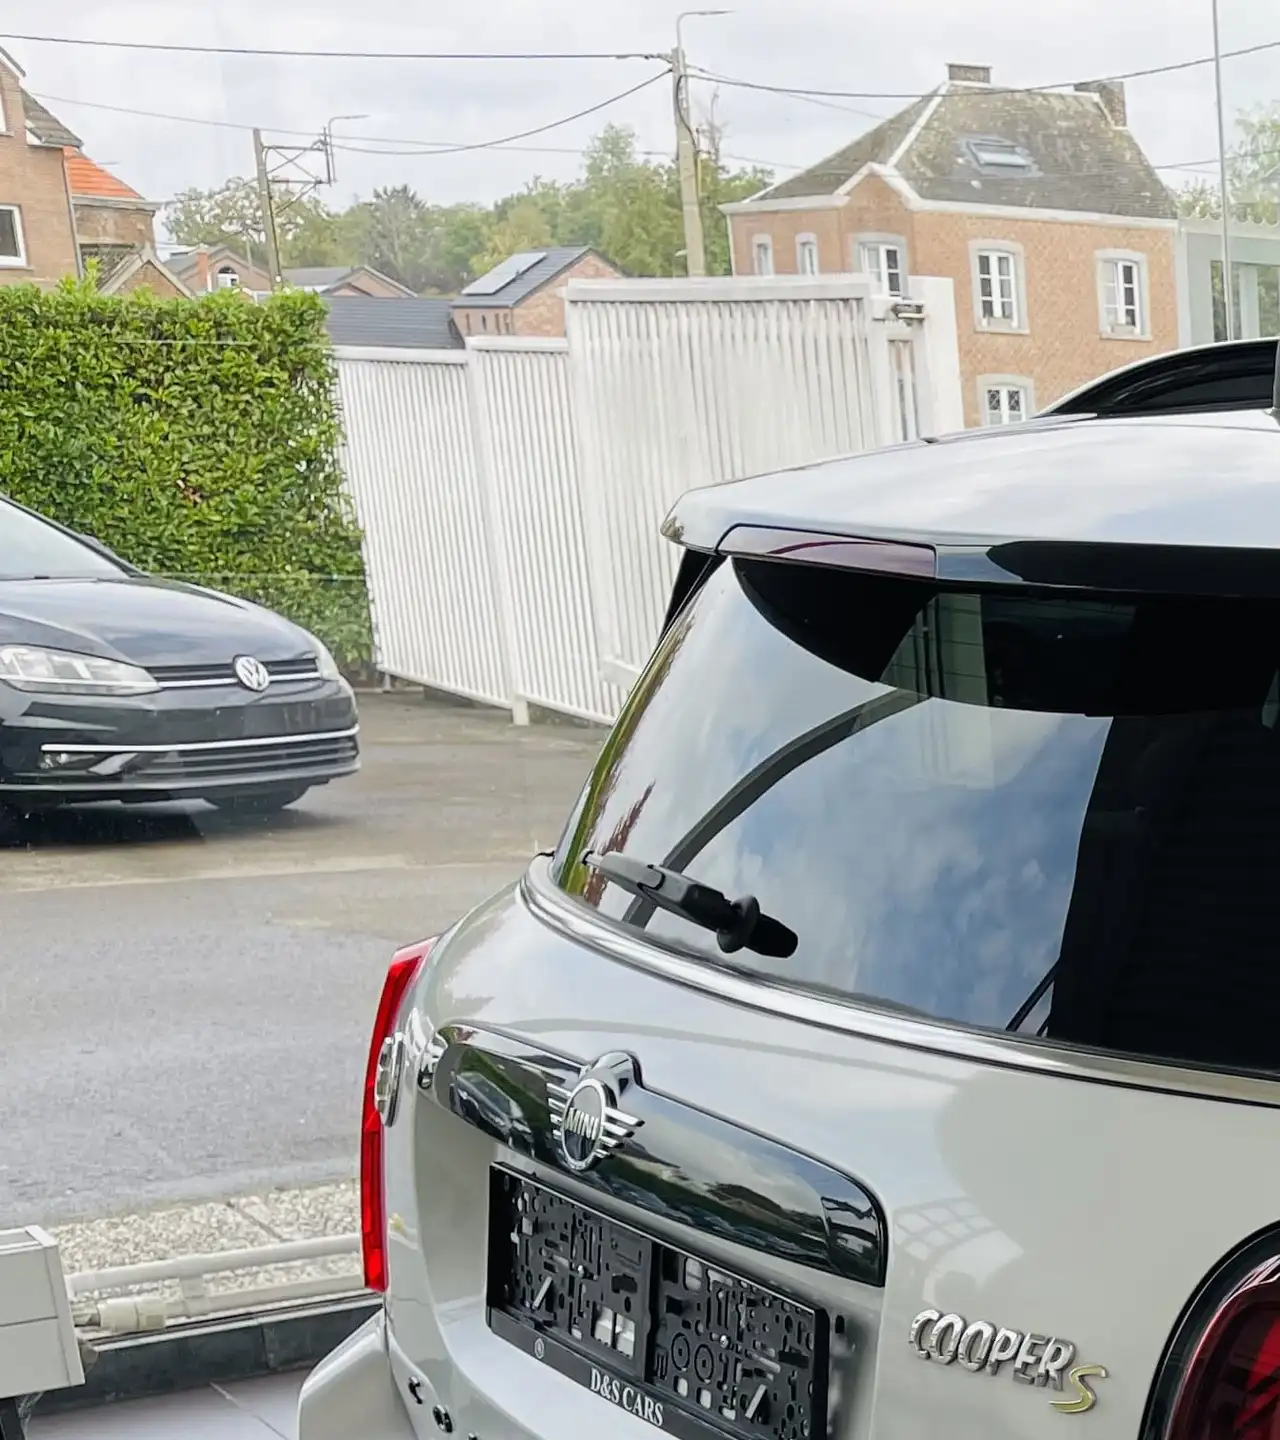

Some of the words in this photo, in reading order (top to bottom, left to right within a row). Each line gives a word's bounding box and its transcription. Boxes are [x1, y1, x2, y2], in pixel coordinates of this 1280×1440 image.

[564, 1106, 600, 1141] MINI
[909, 1309, 1076, 1391] COOPER
[1048, 1364, 1109, 1414] S
[590, 1367, 621, 1404] D&S
[622, 1386, 664, 1427] CARS
